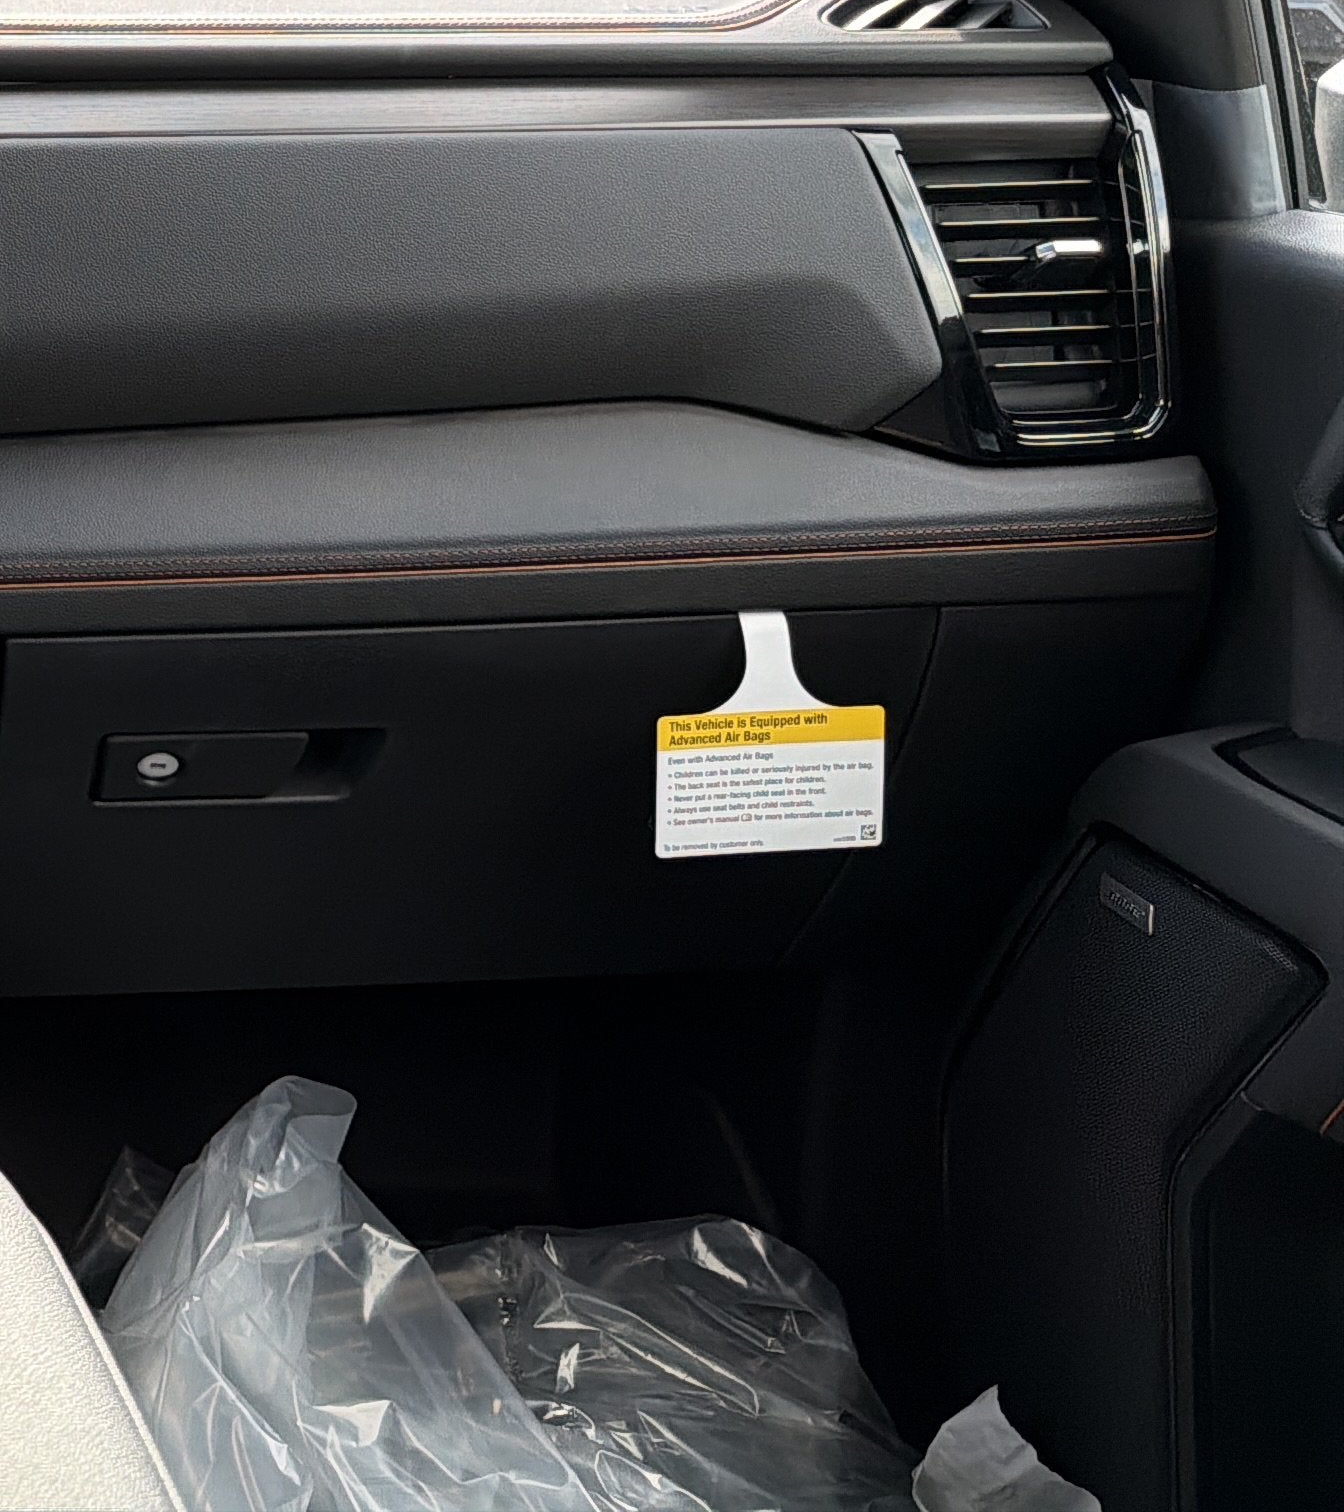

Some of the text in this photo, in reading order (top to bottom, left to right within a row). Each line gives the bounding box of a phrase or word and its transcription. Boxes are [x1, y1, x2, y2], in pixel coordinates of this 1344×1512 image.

[669, 713, 828, 733] This Vehicle is Equipped with
[668, 729, 771, 747] Advanced Air Bags
[667, 757, 686, 766] Even
[705, 753, 741, 762] Advanced
[755, 752, 774, 761] Bags
